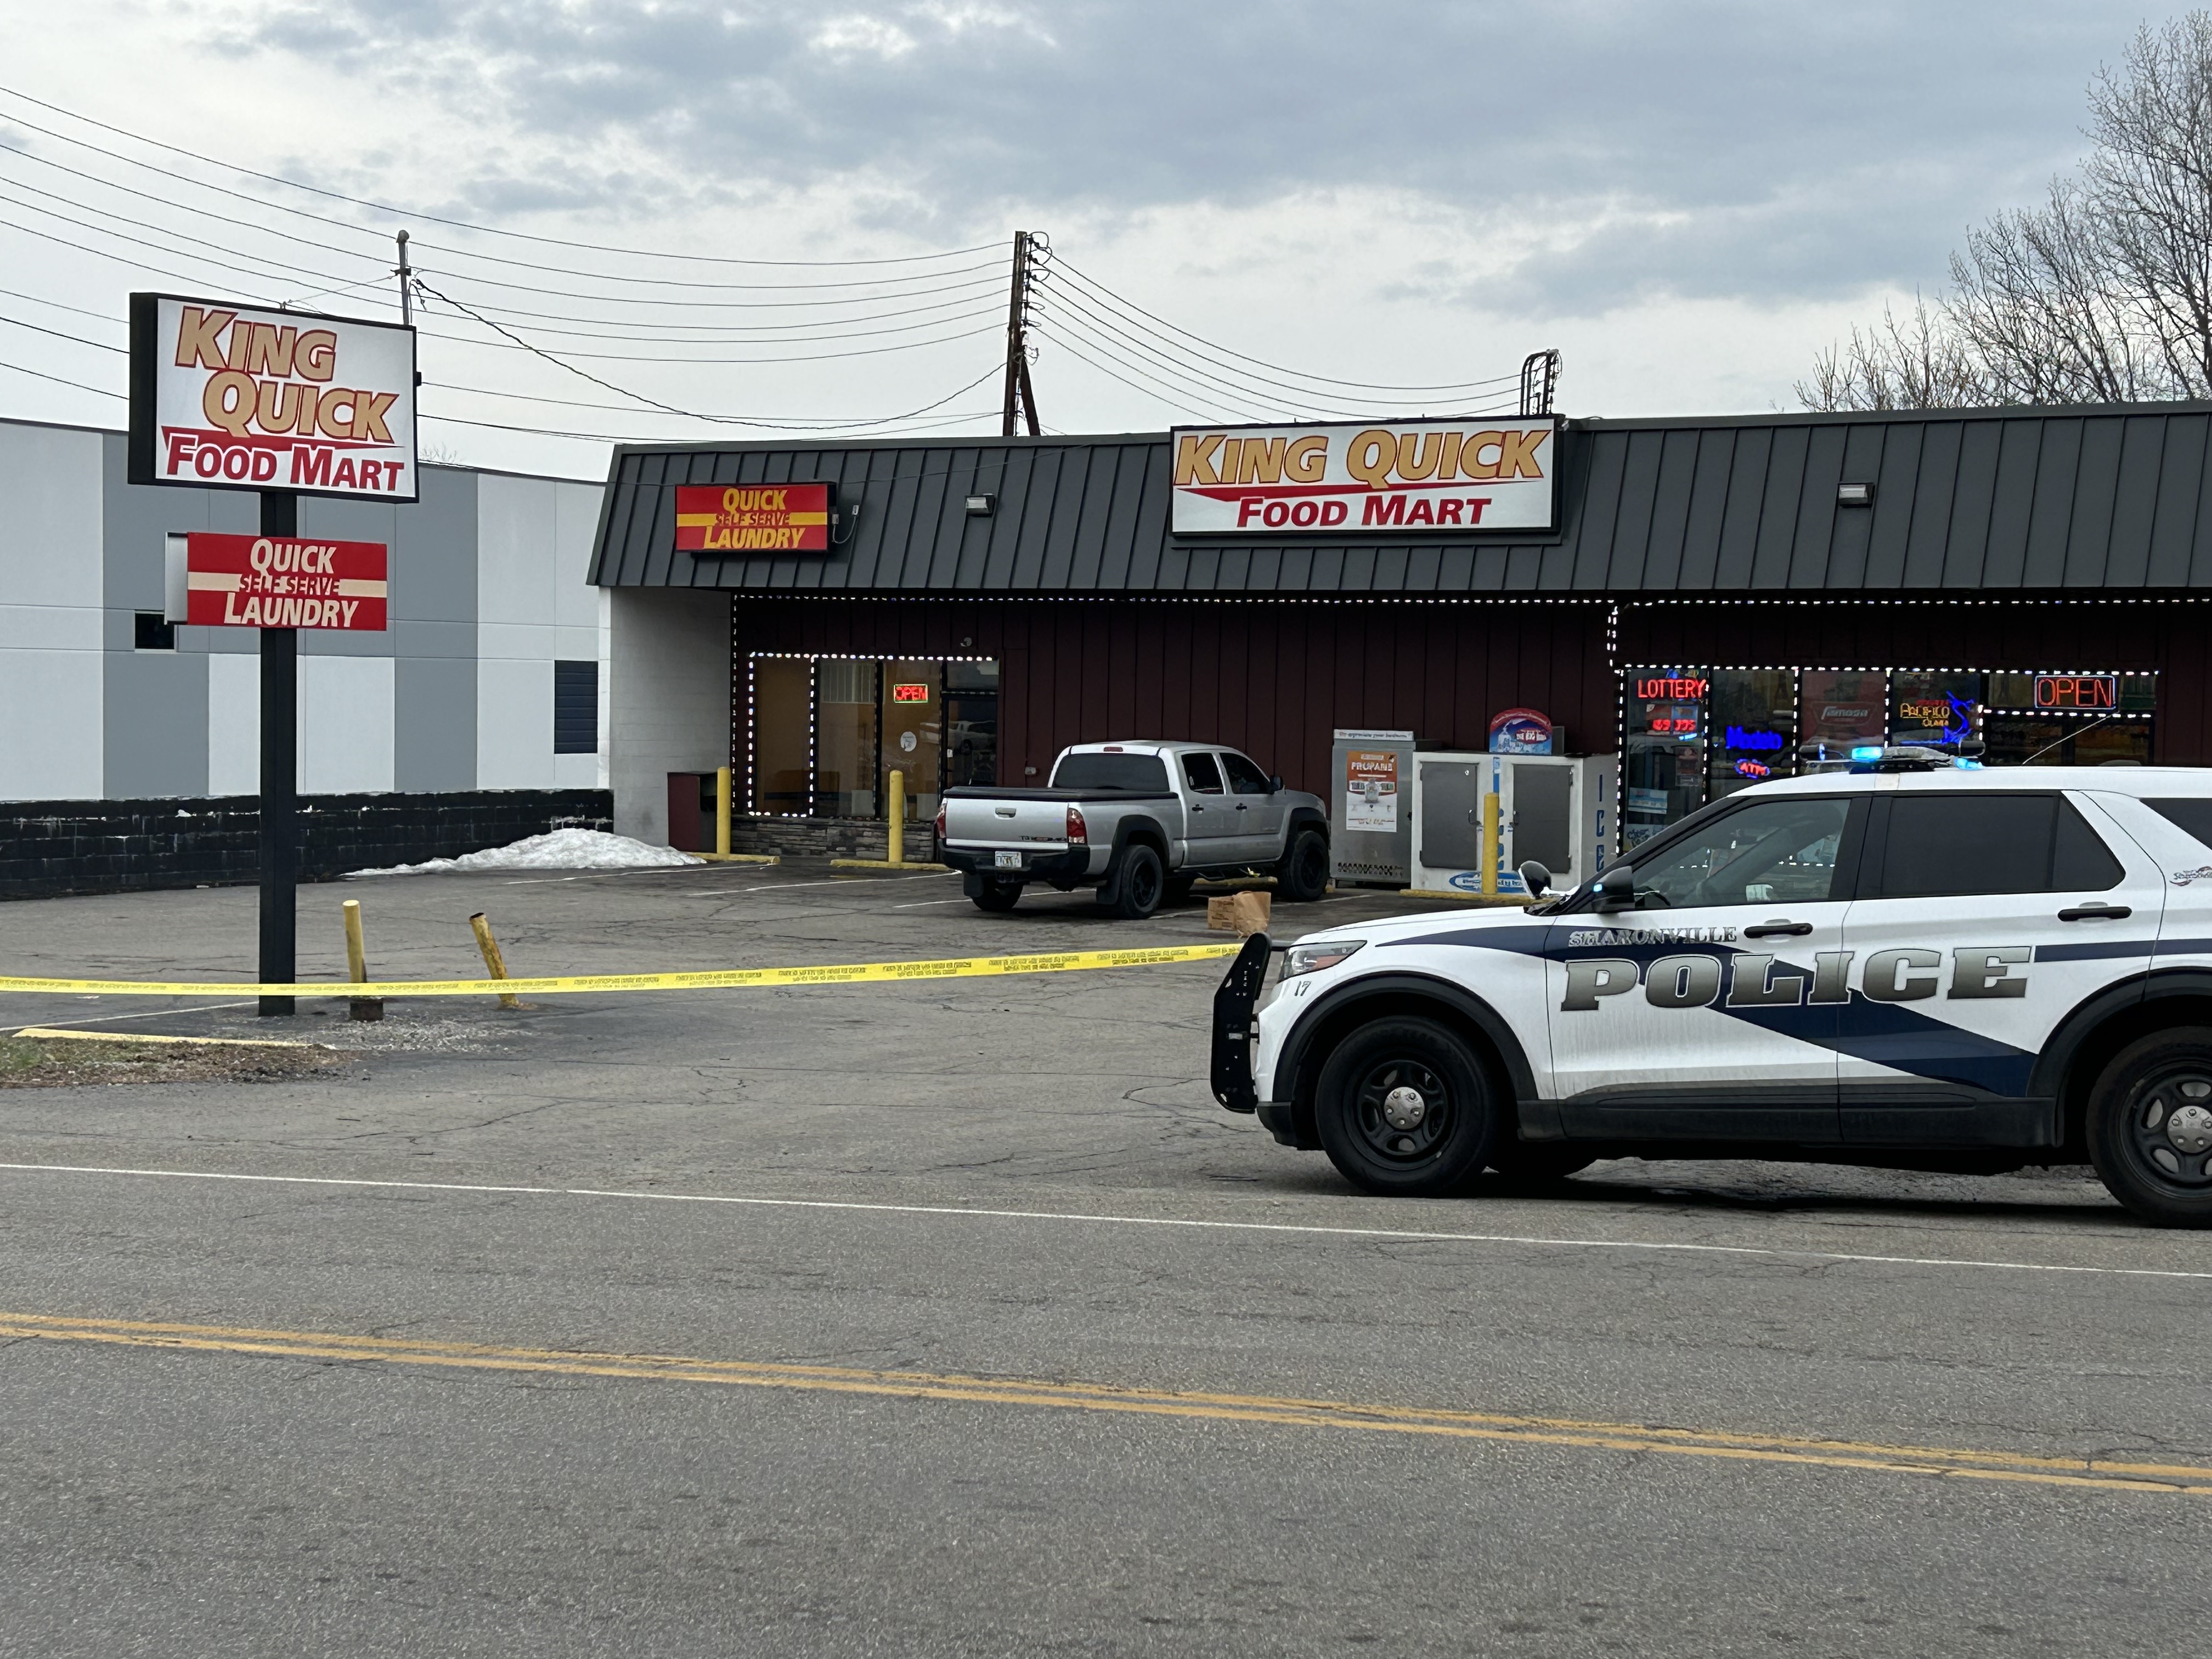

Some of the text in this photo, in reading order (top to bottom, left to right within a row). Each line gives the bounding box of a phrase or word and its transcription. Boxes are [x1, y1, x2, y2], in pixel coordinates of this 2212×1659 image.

[175, 306, 337, 382] KING
[202, 369, 399, 444] QUICK
[166, 435, 404, 491] FOOD MART
[1173, 429, 1551, 489] KING QUICK
[723, 488, 788, 514] QUICK
[1237, 494, 1492, 527] FOOD MART
[749, 512, 790, 526] SERVE
[703, 526, 806, 549] LAUNDRY
[250, 539, 337, 576] QUICK
[240, 574, 339, 596] SELF SERVE
[224, 592, 359, 628] LAUNDRY
[895, 686, 926, 701] OPEN
[1638, 679, 1706, 698] LOTTERY
[2038, 678, 2112, 708] OPEN
[1568, 927, 1737, 947] SHARONVILLE
[1294, 980, 1312, 997] 17
[1561, 945, 2032, 1012] POLICE
